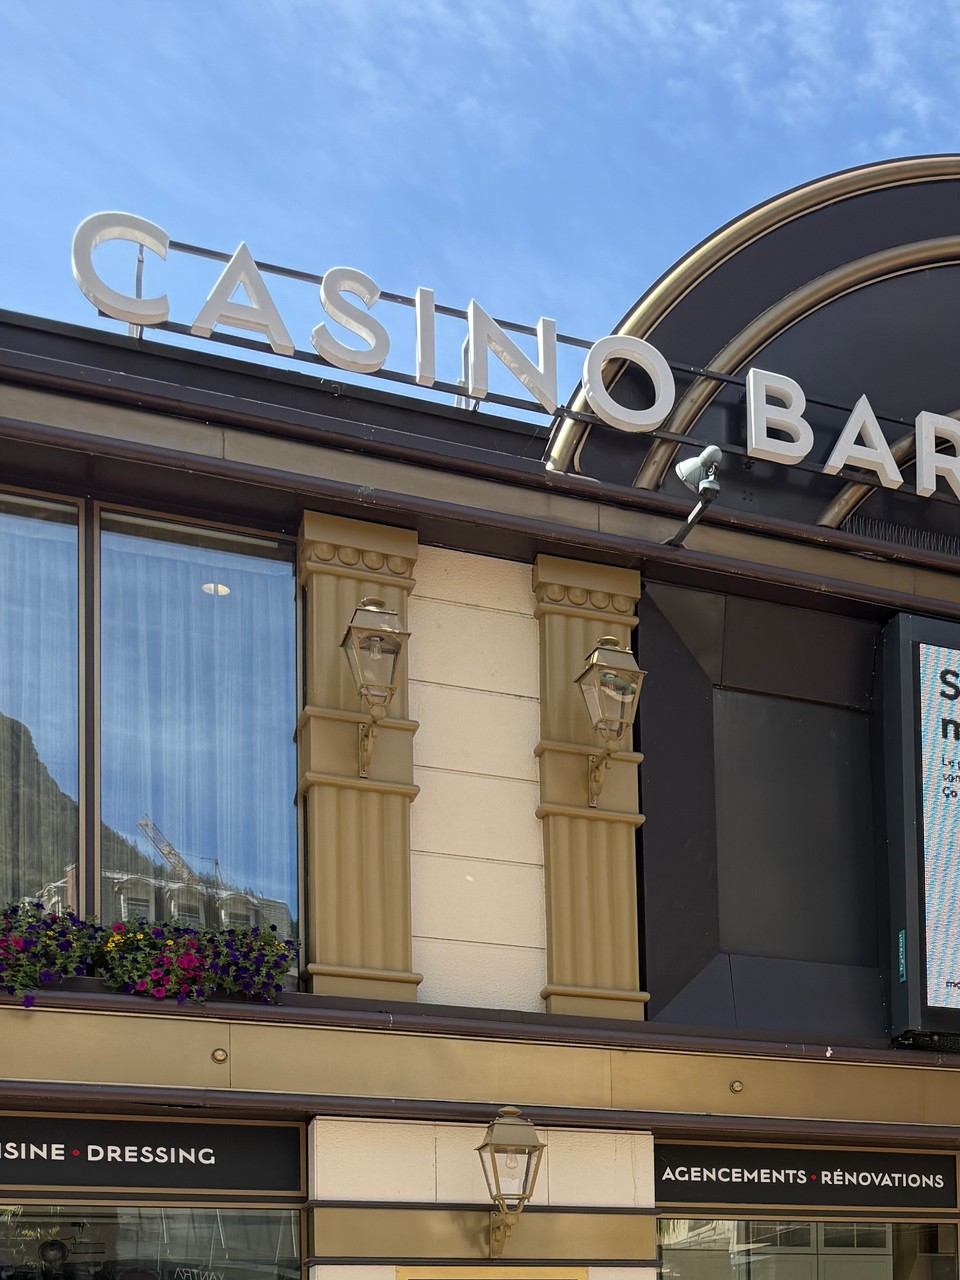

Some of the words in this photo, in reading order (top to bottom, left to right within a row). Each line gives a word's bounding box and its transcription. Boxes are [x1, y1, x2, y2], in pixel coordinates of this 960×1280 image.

[71, 211, 676, 433] CASINO
[0, 1142, 65, 1160] SINE
[87, 1145, 216, 1165] DRESSING
[661, 1166, 807, 1184] AGENCEMENTS
[821, 1168, 944, 1188] RÉNOVATIONS
